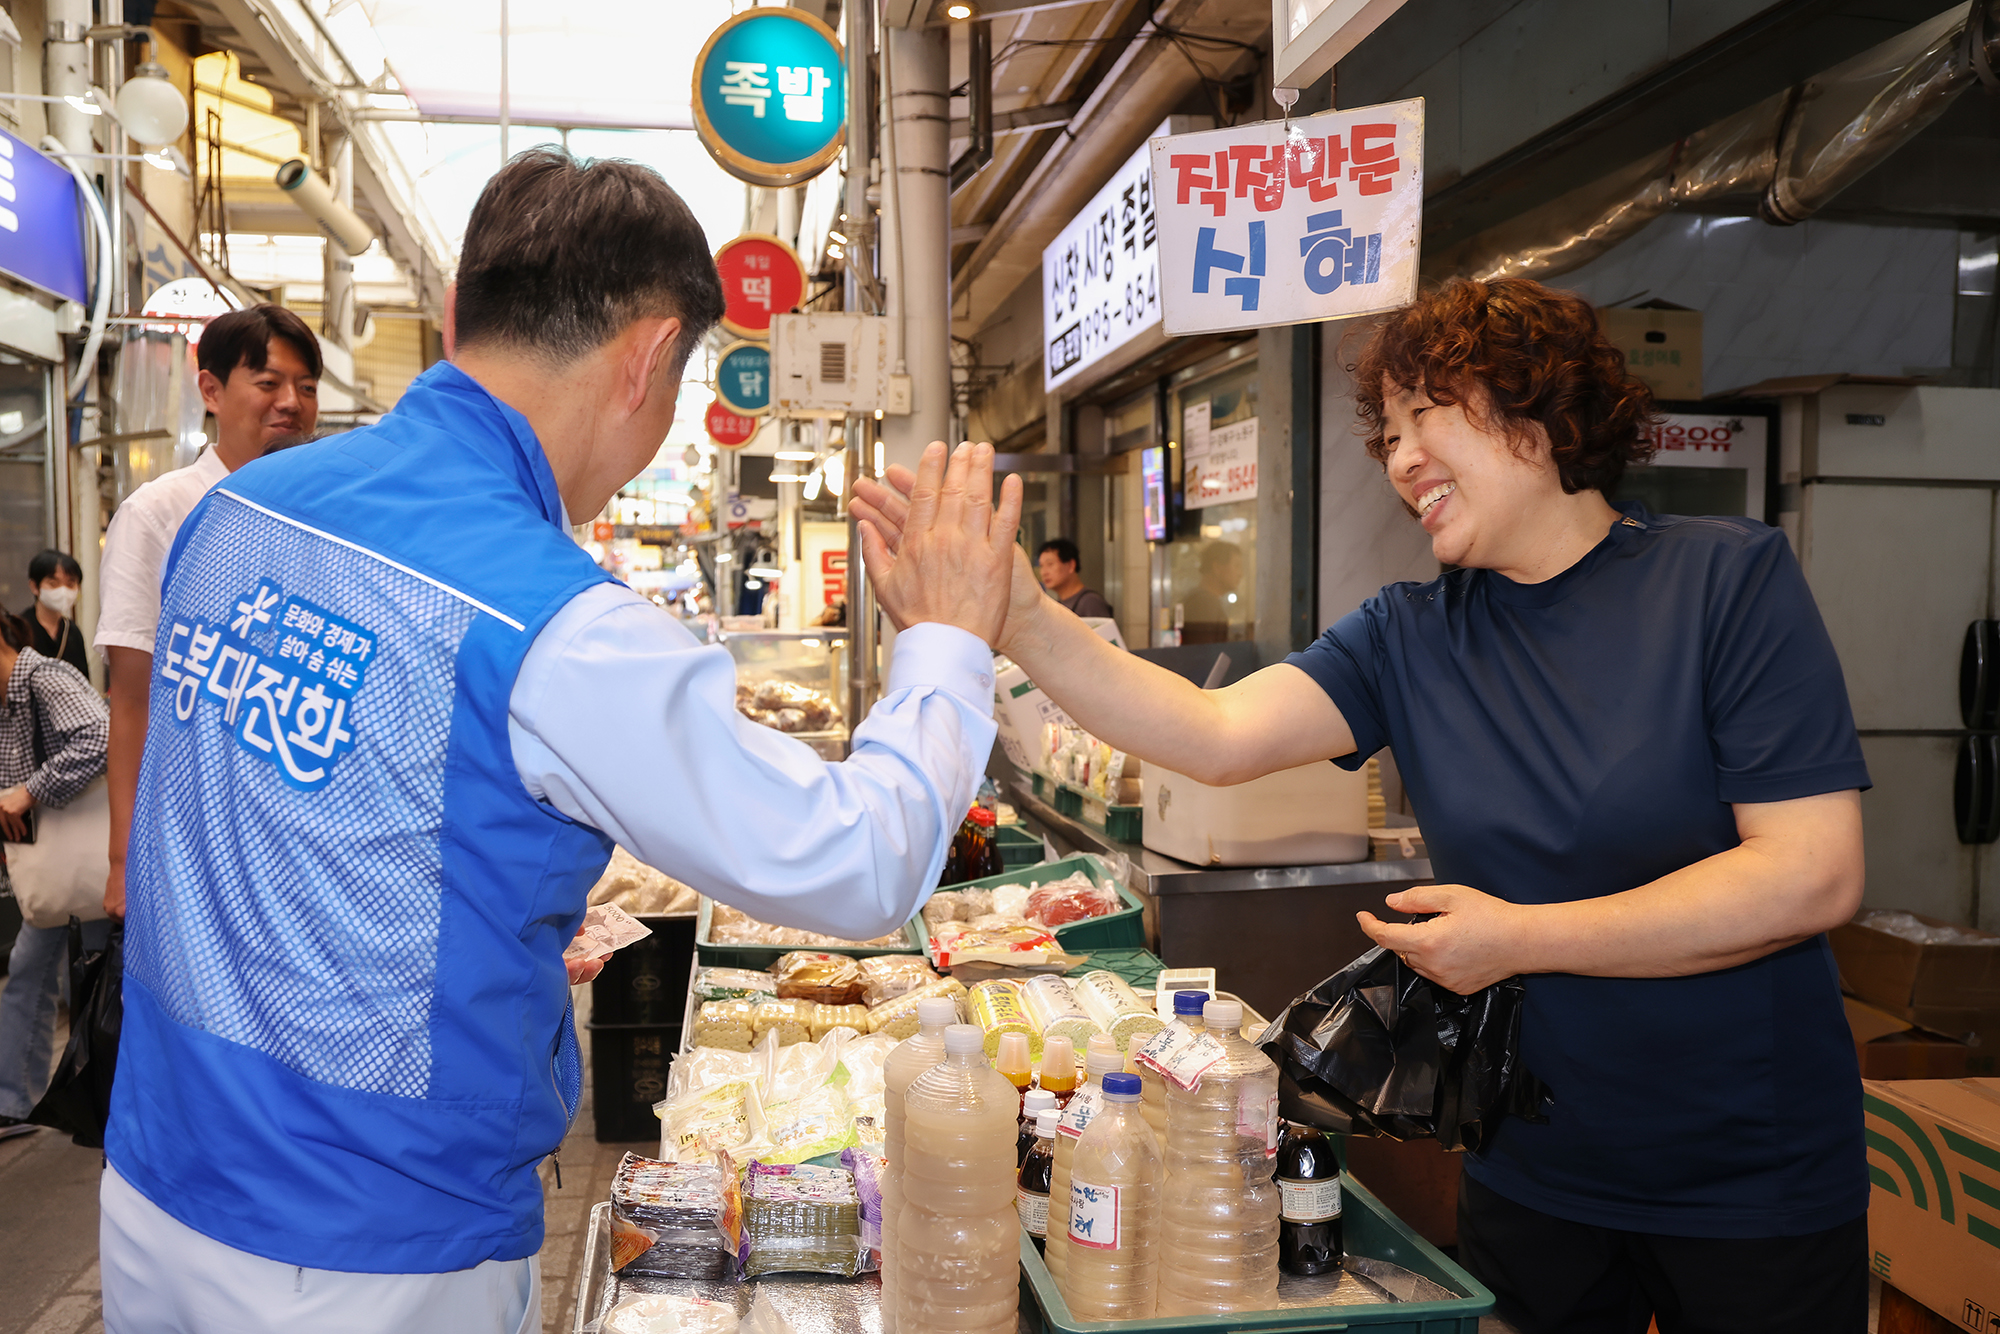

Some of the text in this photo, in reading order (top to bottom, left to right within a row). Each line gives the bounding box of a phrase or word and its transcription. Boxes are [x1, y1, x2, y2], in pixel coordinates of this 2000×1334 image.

[719, 61, 831, 123] 족발
[743, 254, 771, 270] 제일
[741, 276, 771, 311] 떡
[738, 371, 765, 397] 닭
[281, 603, 372, 662] 문화와 경제가
[279, 634, 358, 689] 살아 숨 쉬는
[604, 905, 625, 923] 5000
